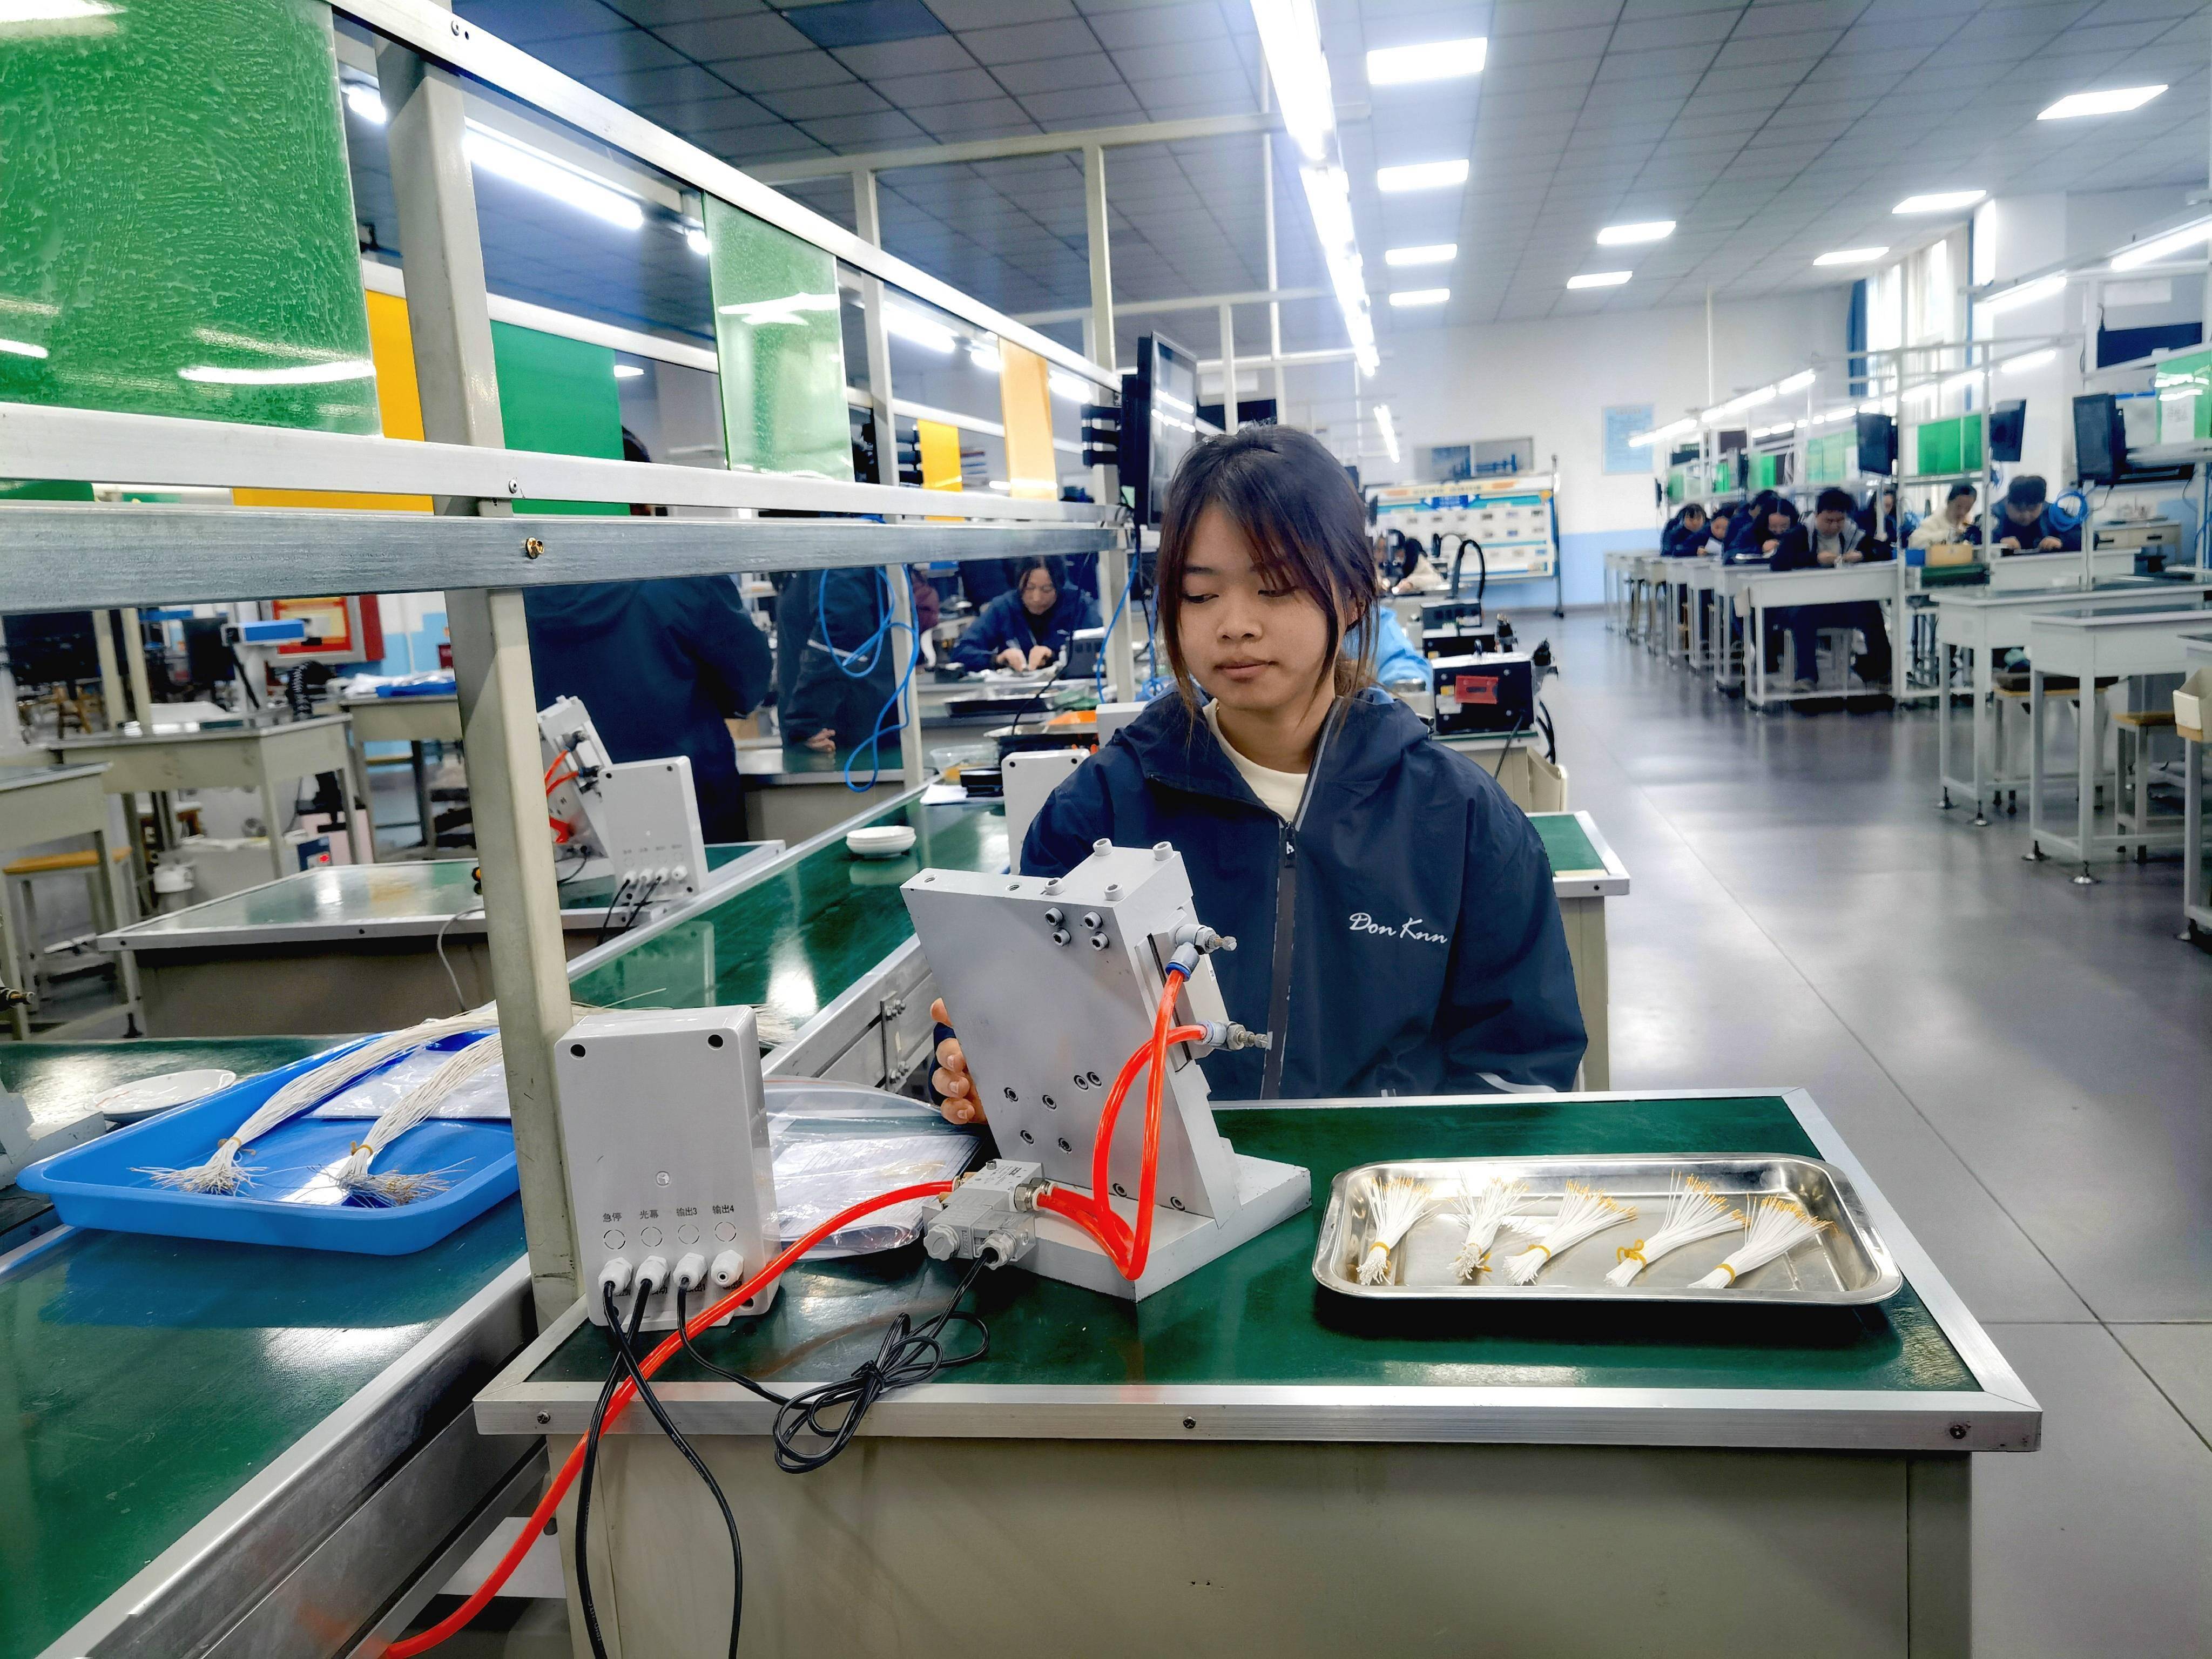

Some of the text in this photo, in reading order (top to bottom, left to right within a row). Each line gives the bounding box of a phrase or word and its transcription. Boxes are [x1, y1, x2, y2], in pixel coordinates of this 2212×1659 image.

[1350, 912, 1397, 936] Don
[603, 1204, 734, 1222] 急停 光幕 输出3 输出4
